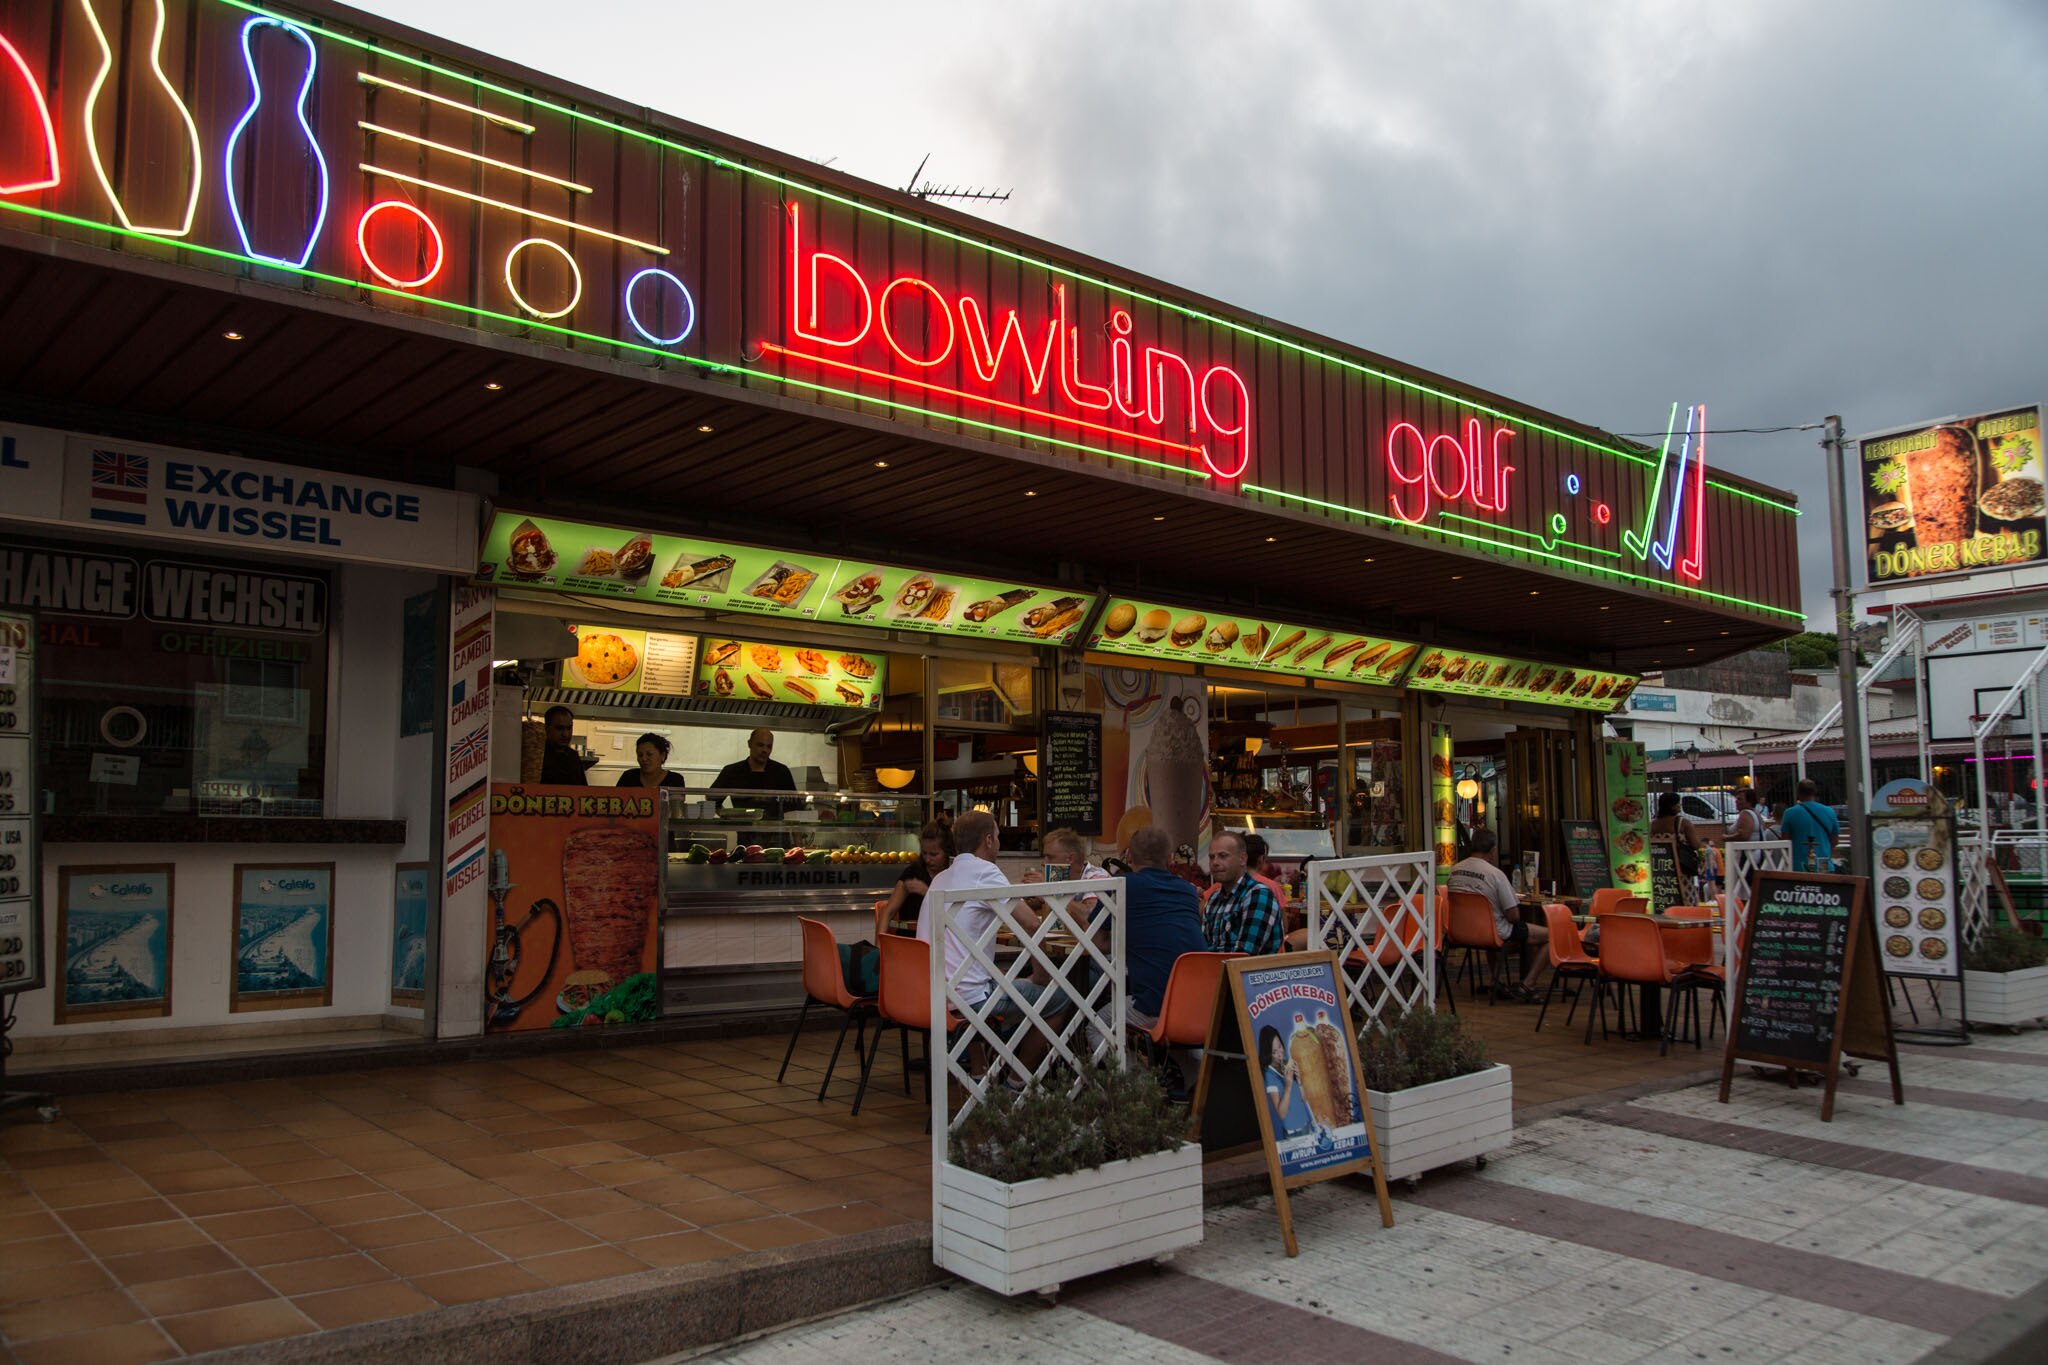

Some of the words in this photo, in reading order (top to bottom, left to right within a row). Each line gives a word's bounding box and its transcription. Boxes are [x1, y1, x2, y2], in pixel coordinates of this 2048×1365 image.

[1977, 412, 2036, 440] PIZZERIA
[1865, 431, 1938, 461] RESTAURANT
[1388, 418, 1515, 523] golf
[165, 461, 420, 523] EXCHANGE
[165, 497, 341, 547] WISSEL
[1875, 542, 1959, 578] DÖNER
[1960, 529, 2040, 566] KEBAB
[150, 564, 321, 632] WECHSEL
[160, 632, 307, 661] OFFIZIELL
[454, 634, 491, 672] CAMBIO
[1927, 623, 1970, 652] AUTOMATIC
[452, 687, 489, 726] CHANGE
[450, 743, 488, 784] EXCHANGE
[448, 800, 486, 840] WECHSEL
[491, 787, 575, 817] DÖNER
[577, 795, 654, 818] KEBAB
[446, 858, 485, 898] WISSEL
[738, 871, 860, 885] FRIKANDELA
[1773, 890, 1840, 906] COSTADORO
[1249, 973, 1265, 985] BEST
[1264, 969, 1289, 983] QUALITY
[1289, 968, 1303, 980] FOR
[1303, 965, 1326, 977] EUROPE
[1248, 985, 1291, 1018] DÖNER
[1292, 984, 1335, 1006] KEBAB
[1291, 1146, 1318, 1161] AVRUPA
[1334, 1137, 1356, 1151] KEBAB
